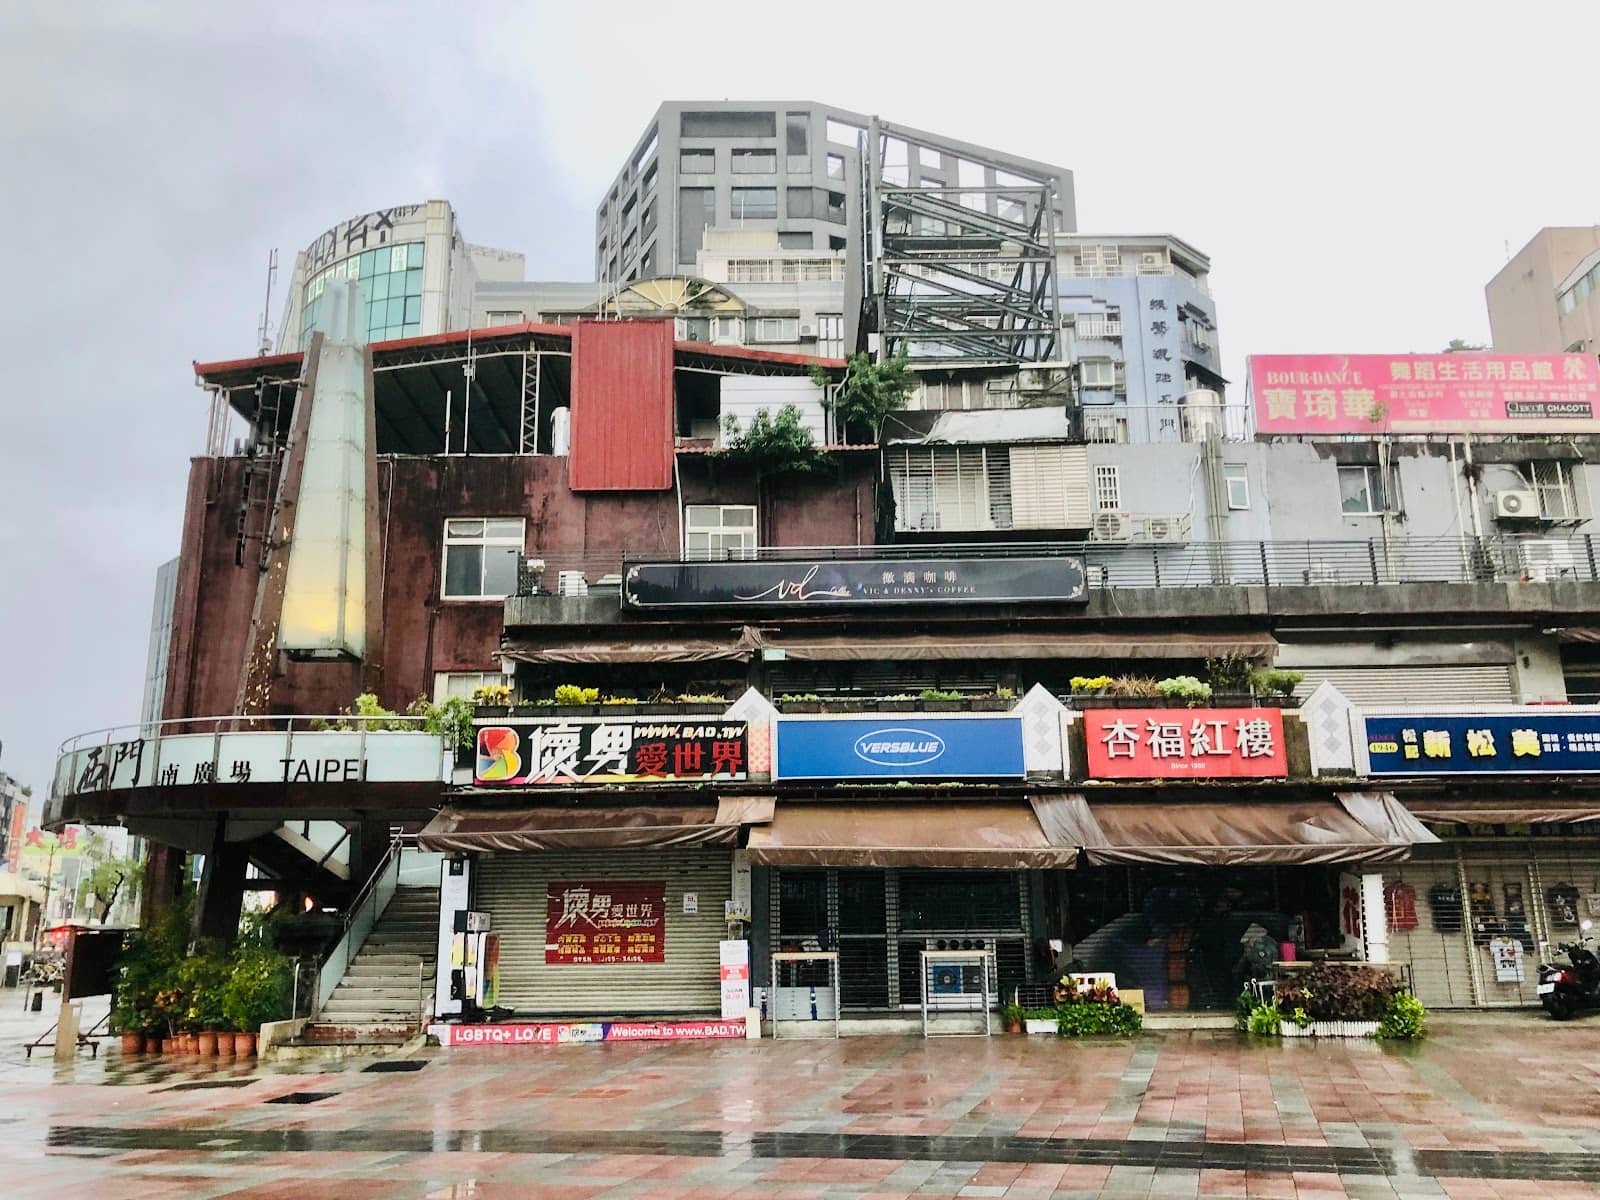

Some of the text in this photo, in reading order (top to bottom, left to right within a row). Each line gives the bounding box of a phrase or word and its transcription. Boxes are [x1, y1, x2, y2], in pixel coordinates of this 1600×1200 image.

[1390, 360, 1554, 381] 舞蹈生活用品館
[1263, 388, 1375, 420] 寶琦華
[1547, 404, 1590, 412] CHACOTT
[937, 585, 977, 593] COFFEE
[861, 741, 940, 754] VERSBLUE
[1102, 718, 1276, 759] 杏福紅樓
[77, 738, 252, 793] 西門 南廣場
[635, 741, 743, 779] 愛世界
[279, 759, 368, 783] TAIPEI
[455, 1028, 511, 1042] LGBTQ+
[611, 1025, 660, 1037] Welcome
[663, 1026, 673, 1036] to
[675, 1024, 746, 1036] www.BAD.TW
